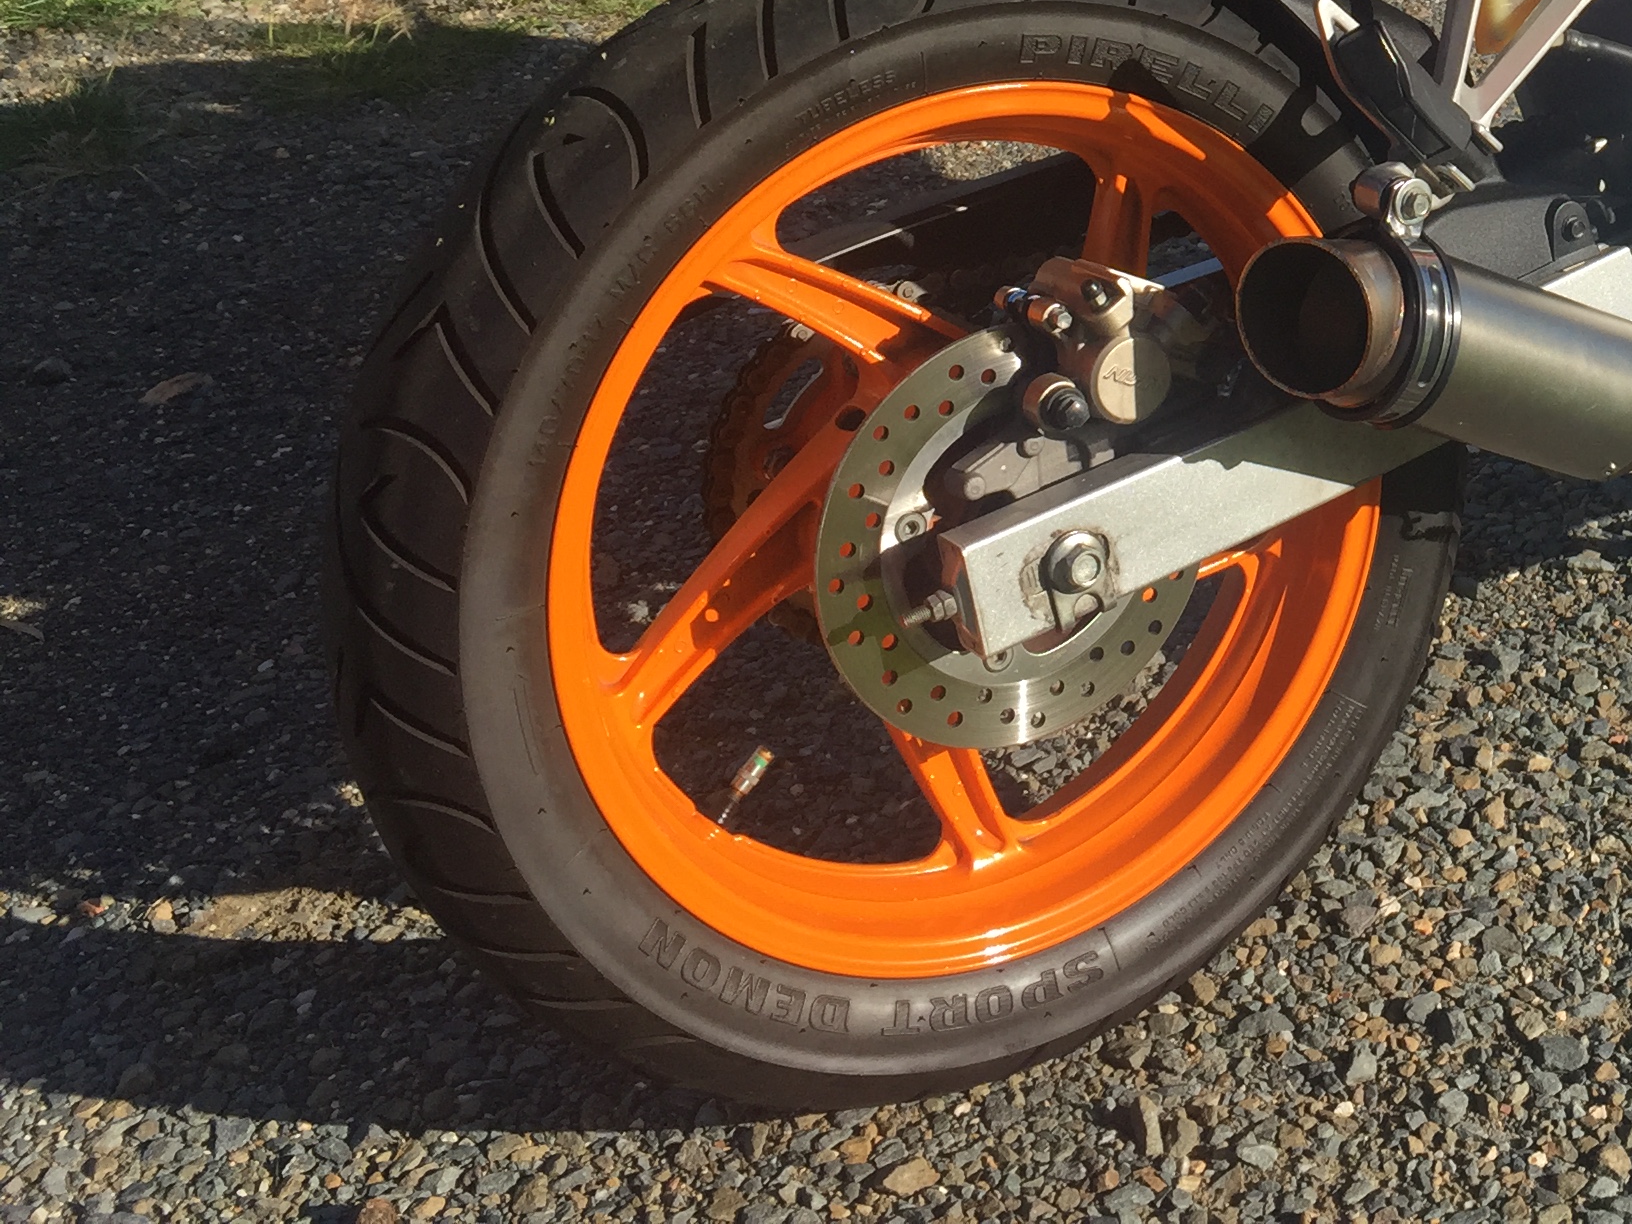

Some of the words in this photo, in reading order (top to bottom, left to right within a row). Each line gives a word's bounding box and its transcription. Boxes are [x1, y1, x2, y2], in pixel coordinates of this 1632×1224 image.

[1019, 33, 1275, 134] PIRELLI
[637, 916, 852, 1035] DEMON
[880, 949, 1106, 1036] SPORT
